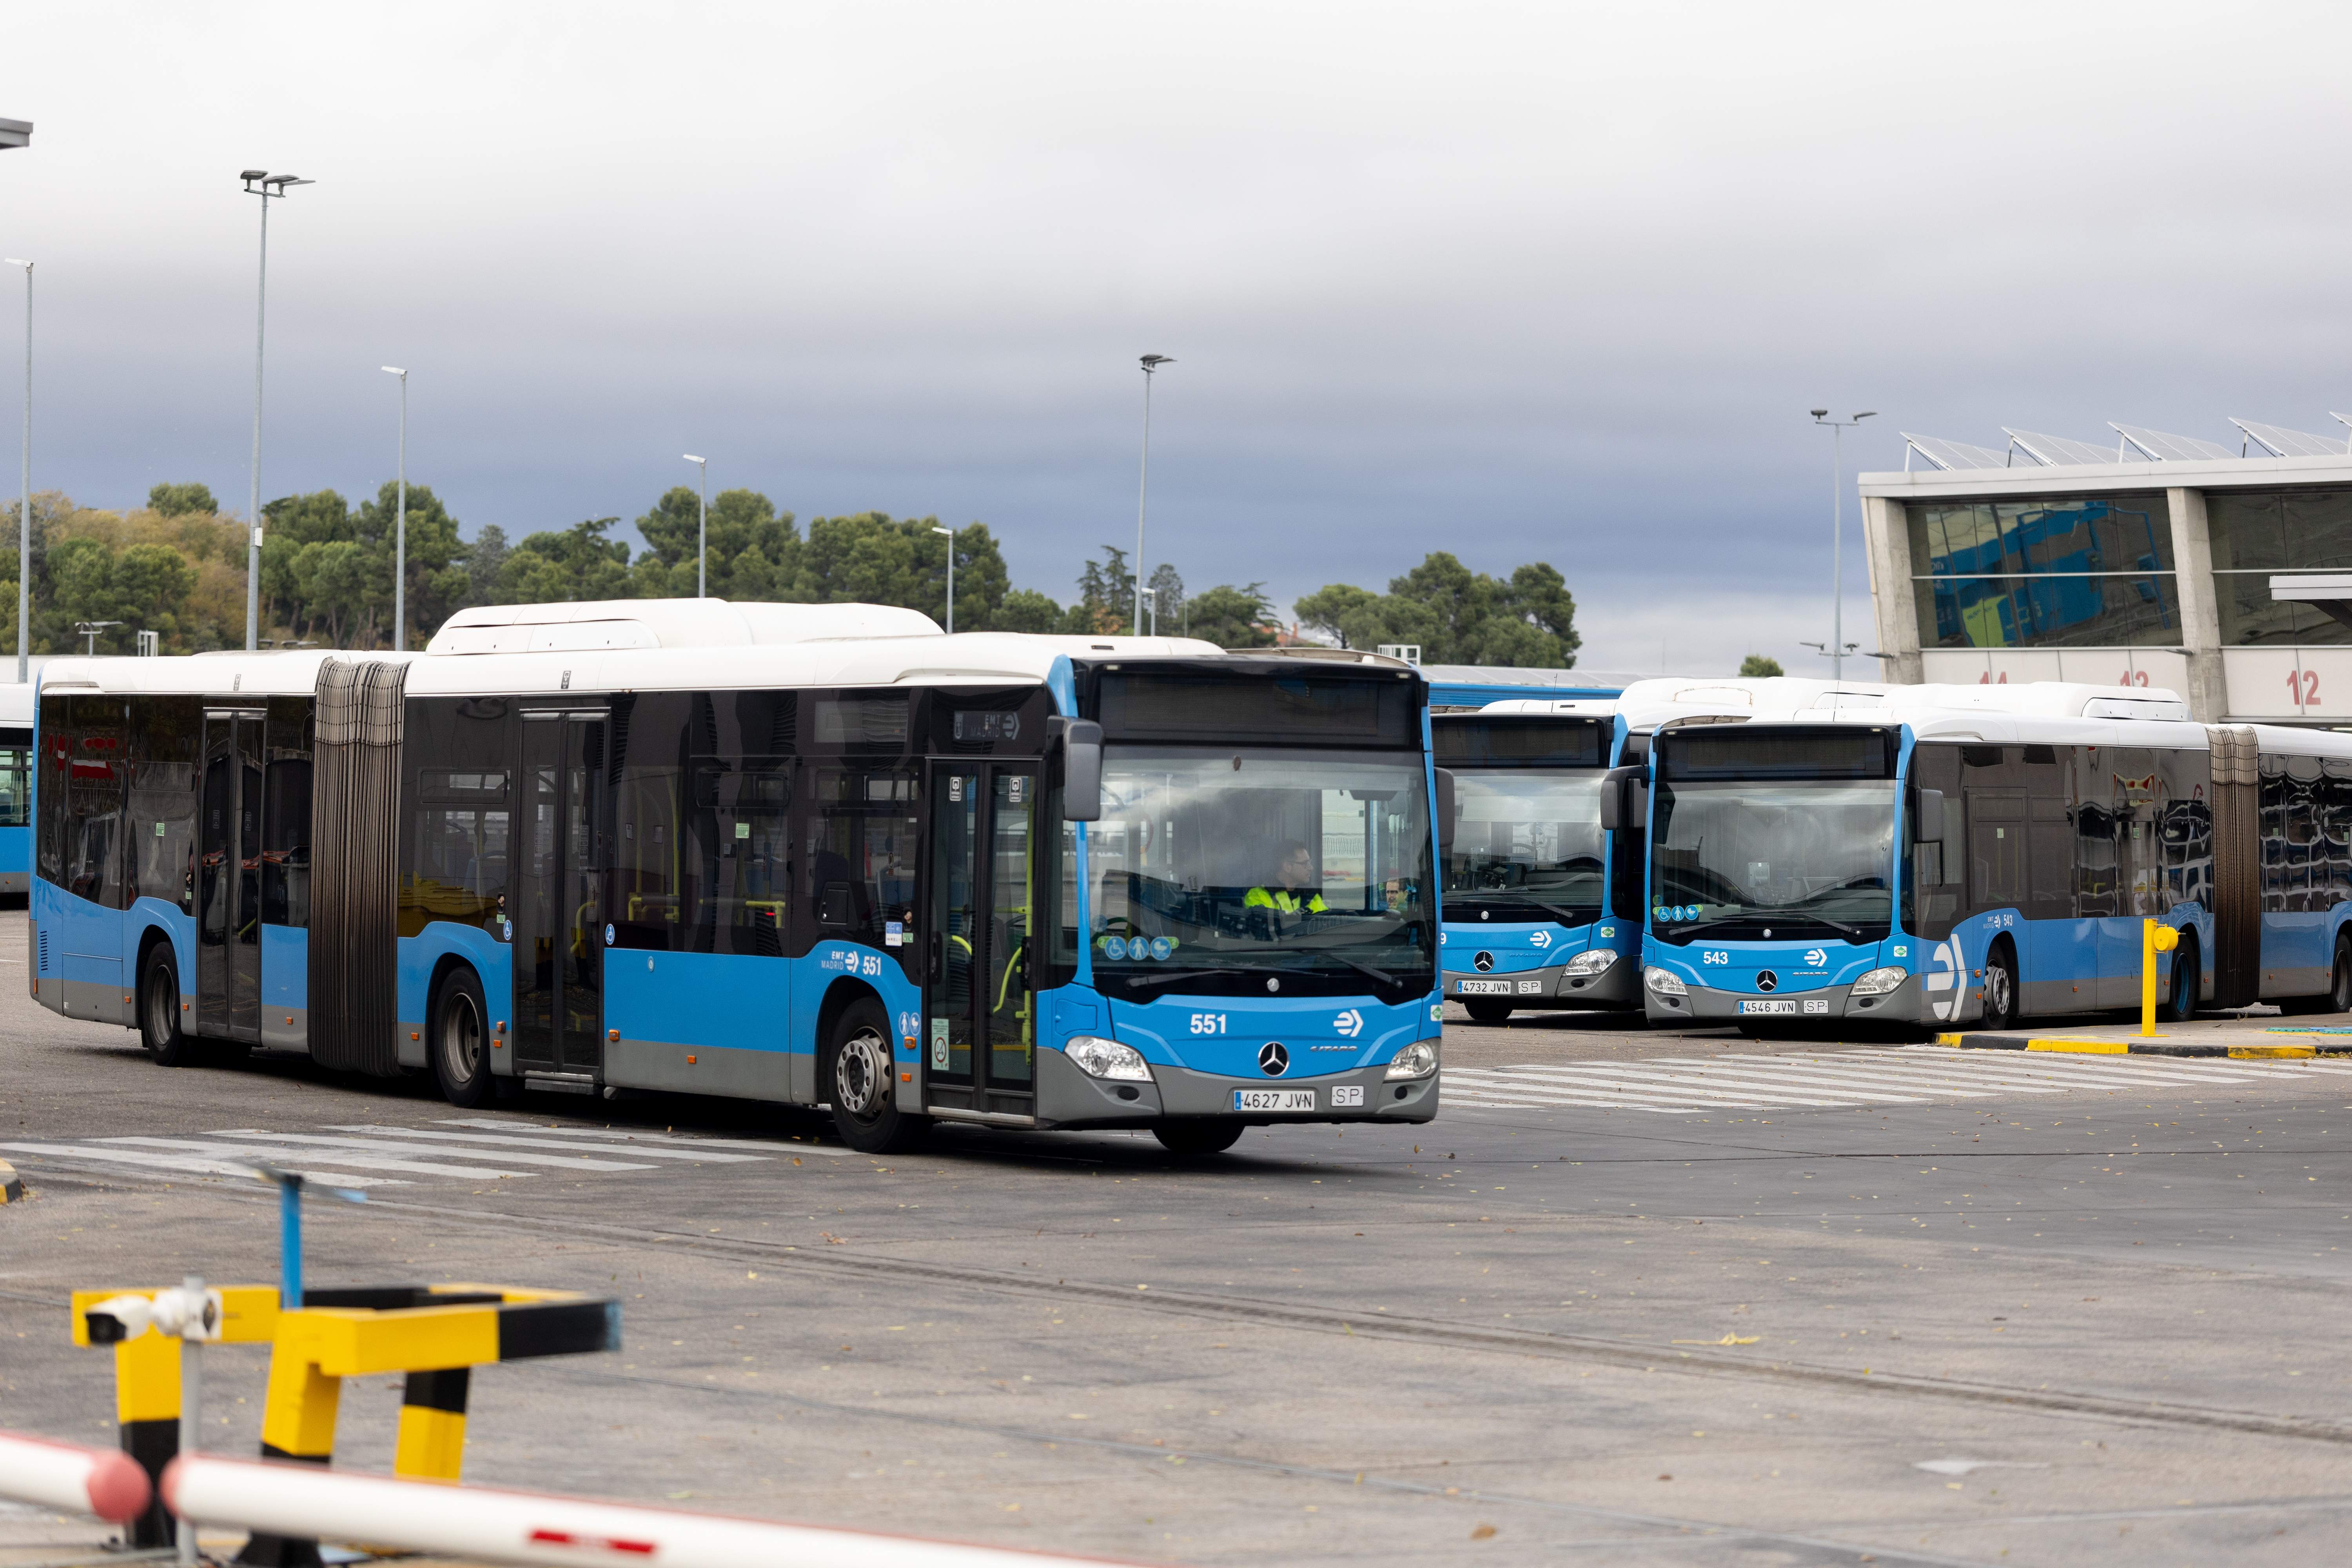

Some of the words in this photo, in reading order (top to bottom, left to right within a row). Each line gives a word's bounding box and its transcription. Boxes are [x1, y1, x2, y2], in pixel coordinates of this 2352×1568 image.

[2287, 670, 2321, 705] 12
[2004, 915, 2013, 926] 543
[831, 951, 844, 960] EMT
[1703, 951, 1728, 964] 543
[821, 960, 844, 970] MADRID
[863, 956, 881, 976] 551
[1463, 983, 1487, 992] 4732
[1491, 983, 1508, 992] JVN
[1745, 1003, 1771, 1012] 4546
[1775, 1003, 1793, 1012] JVN
[1190, 1014, 1226, 1034] 551
[1244, 1094, 1279, 1108] 4627
[1285, 1094, 1312, 1108] JVN
